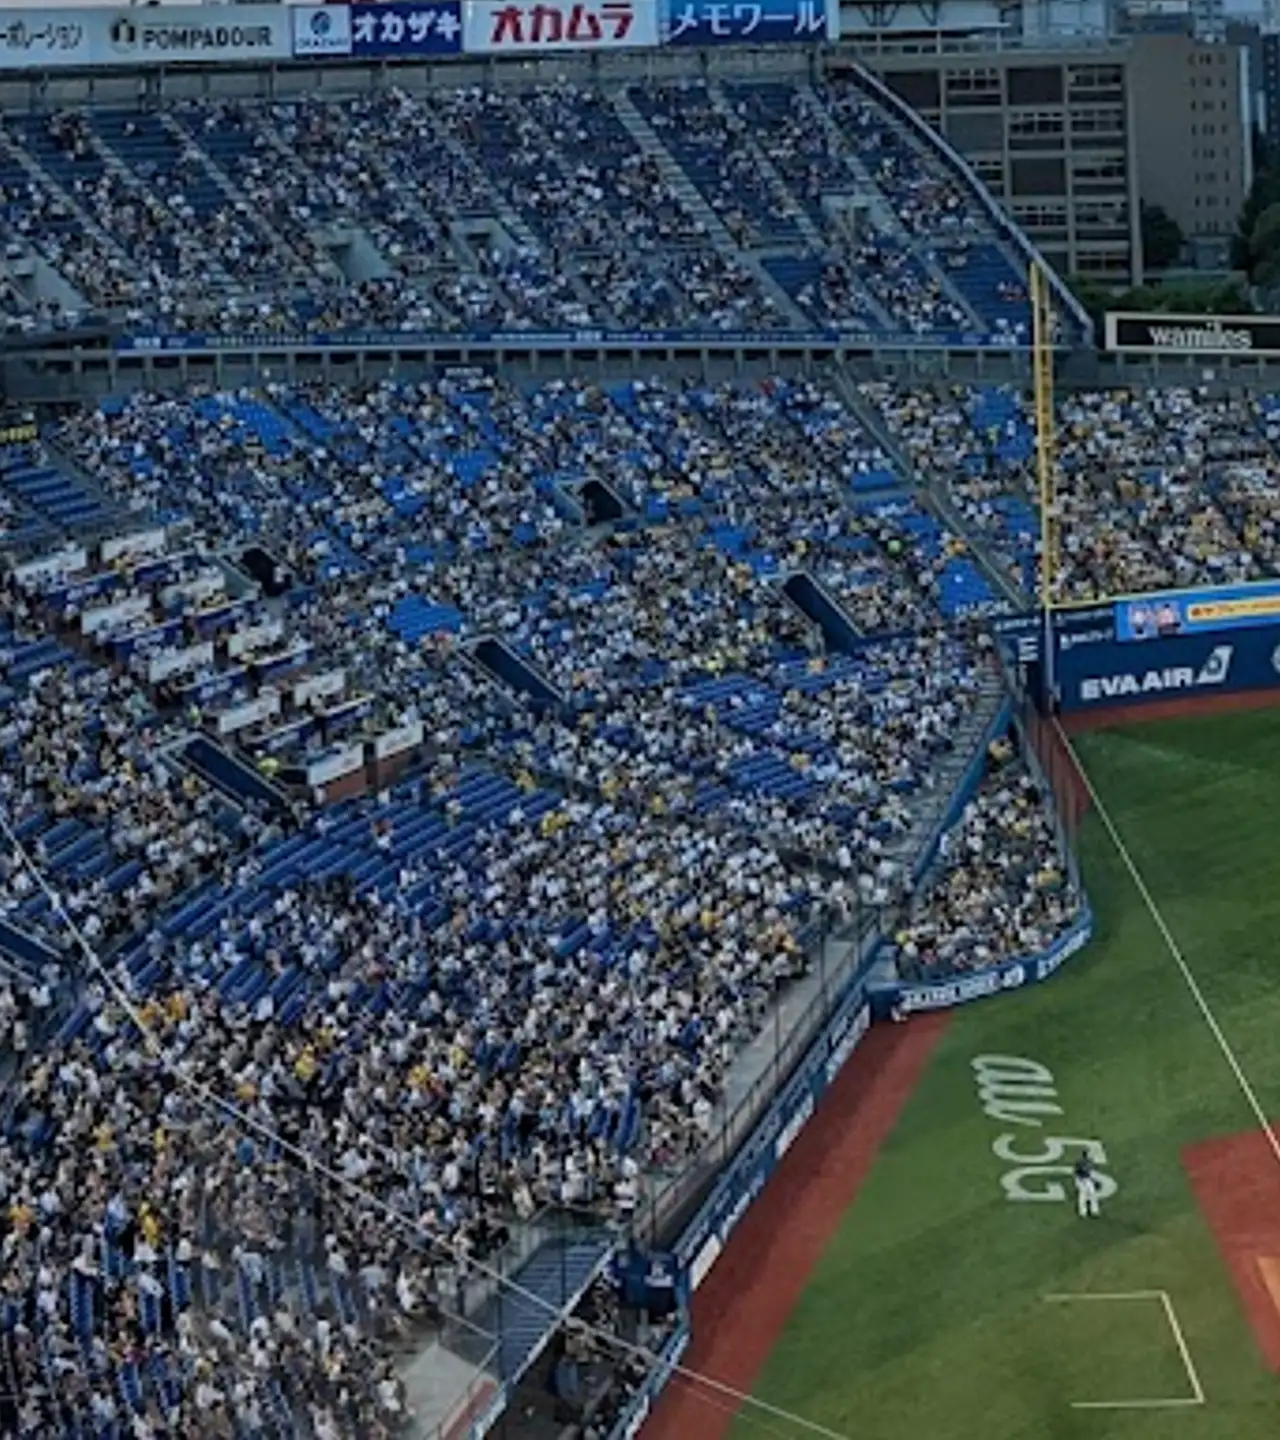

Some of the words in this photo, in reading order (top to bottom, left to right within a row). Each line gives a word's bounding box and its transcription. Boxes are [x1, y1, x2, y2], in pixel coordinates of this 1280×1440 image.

[353, 10, 461, 43] オカザキ
[490, 3, 634, 42] オカムラ
[672, 0, 825, 36] メモワール
[143, 25, 273, 51] POMPADOUR
[1148, 321, 1252, 349] wamiles
[1080, 672, 1140, 700] EVA
[1141, 667, 1194, 692] AIR
[970, 1054, 1065, 1128] au
